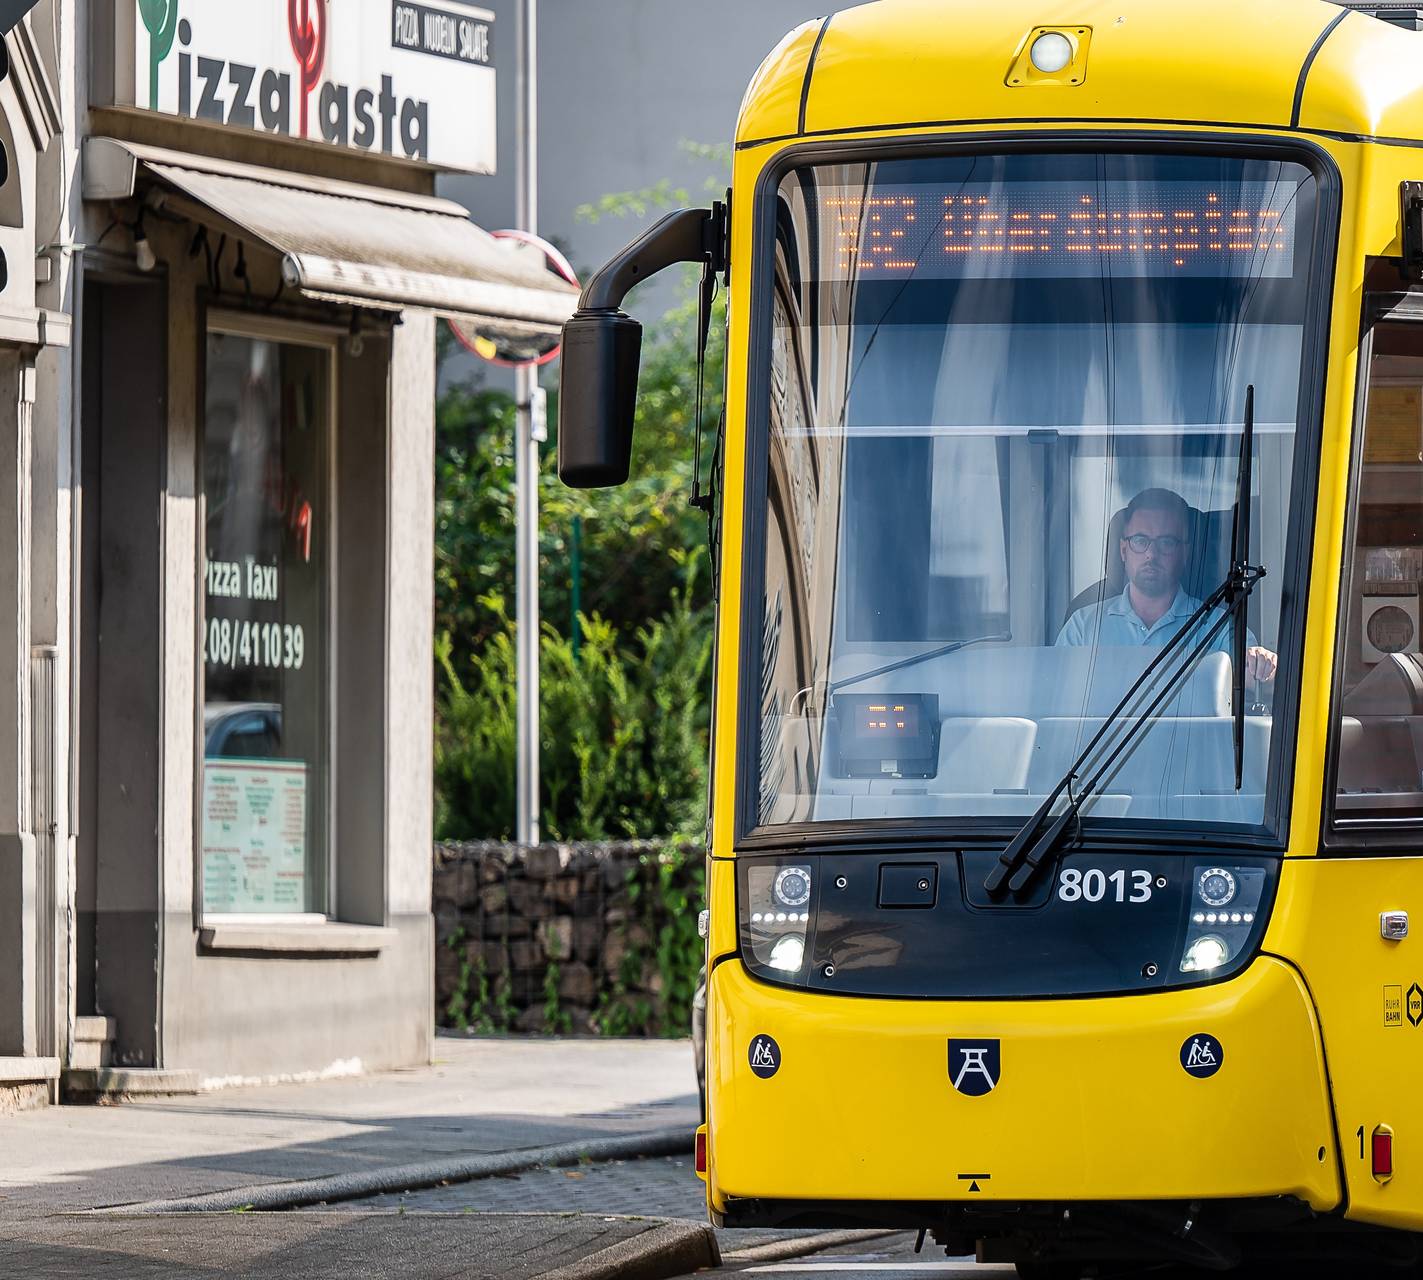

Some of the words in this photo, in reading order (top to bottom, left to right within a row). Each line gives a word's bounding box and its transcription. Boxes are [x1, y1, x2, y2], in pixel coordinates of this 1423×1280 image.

[395, 5, 420, 47] PIZZA
[424, 12, 457, 55] NUDELN
[459, 20, 489, 62] SALATE
[245, 553, 278, 601] Taxi
[1058, 868, 1152, 903] 8013
[1385, 999, 1400, 1010] RUHR
[1385, 1011, 1400, 1022] BAHN
[1410, 1000, 1421, 1010] VRR
[1356, 1125, 1365, 1160] 1
